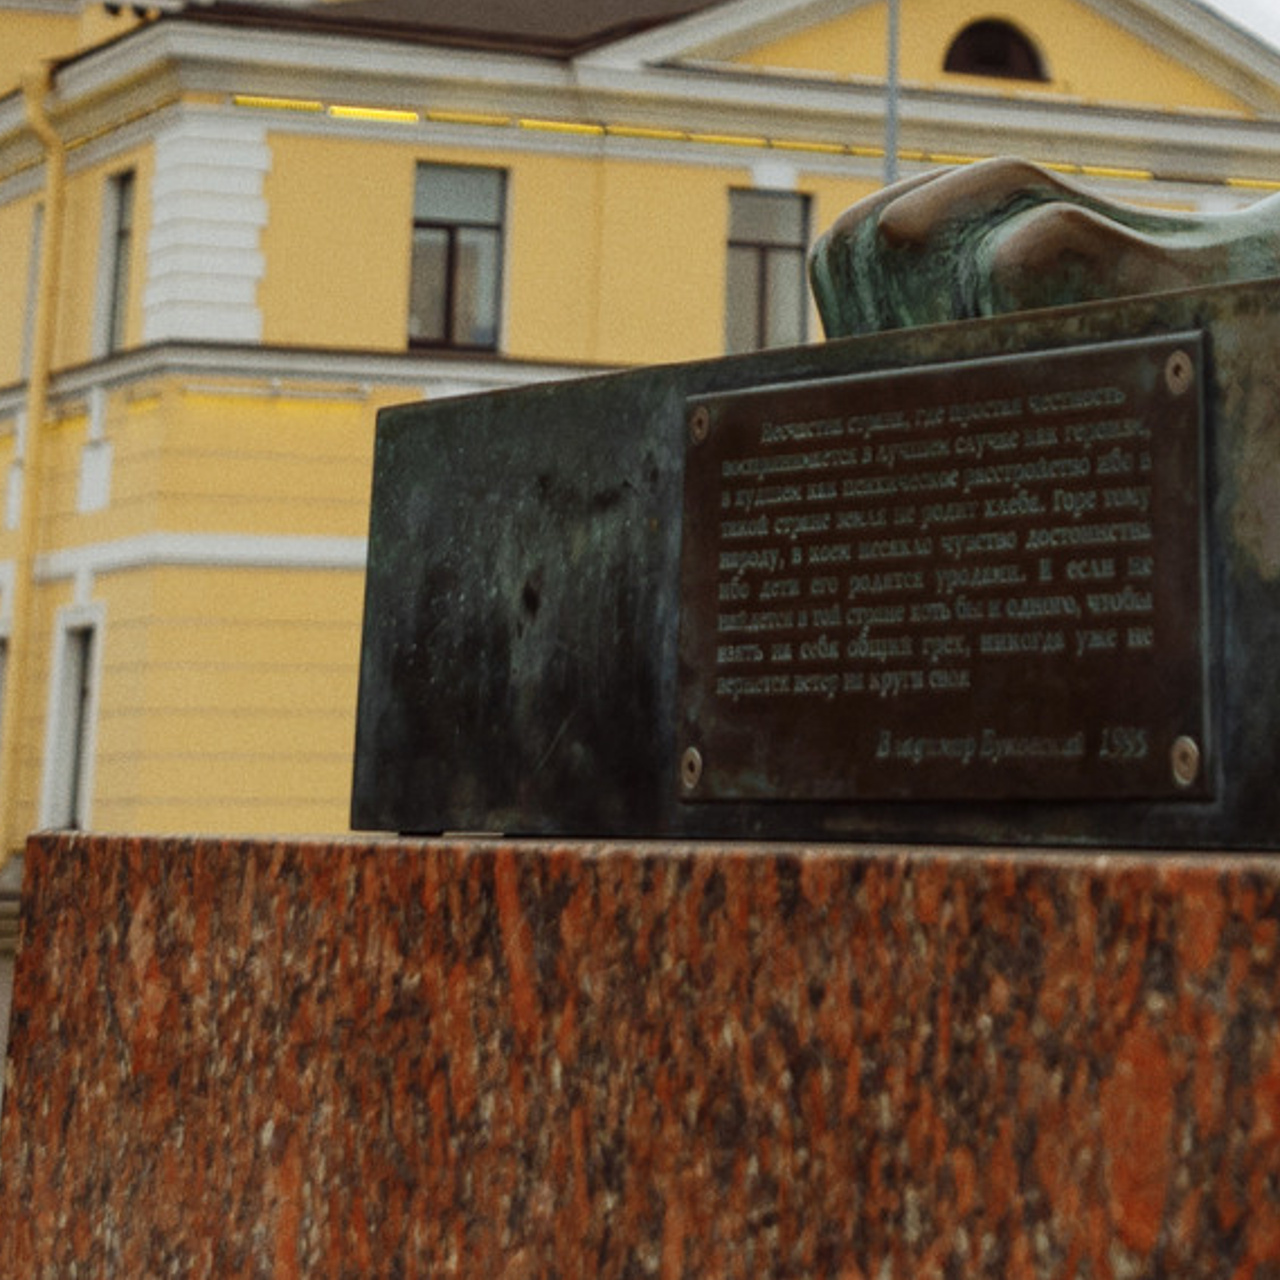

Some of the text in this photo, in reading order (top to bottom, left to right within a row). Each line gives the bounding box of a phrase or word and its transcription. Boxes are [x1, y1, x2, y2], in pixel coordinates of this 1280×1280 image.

[915, 406, 945, 426] где
[949, 398, 1022, 428] простая
[1028, 387, 1126, 413] честность
[862, 446, 872, 463] в
[955, 430, 1019, 459] случае
[1024, 427, 1058, 447] как
[721, 490, 731, 509] в
[807, 481, 837, 500] как
[1139, 452, 1152, 471] в
[721, 513, 768, 538] такой
[774, 513, 830, 539] стране
[836, 508, 887, 529] земля
[893, 506, 916, 525] не
[920, 501, 978, 530] родит
[1052, 489, 1097, 518] Горе
[1102, 486, 1152, 512] тому
[719, 548, 785, 576] народу,
[791, 547, 802, 565] в
[808, 544, 851, 563] коем
[858, 538, 933, 559] иссякло
[941, 531, 1018, 559] чувство
[719, 577, 750, 600] ибо
[759, 578, 800, 601] дети
[810, 576, 838, 595] его
[848, 572, 924, 599] родятся
[1038, 557, 1053, 581] И
[1066, 557, 1115, 580] если
[1127, 556, 1154, 576] не
[797, 609, 808, 627] в
[812, 603, 841, 626] той
[846, 606, 904, 632] стране
[910, 602, 951, 622] хоть
[956, 595, 983, 620] бы
[1006, 595, 1081, 619] одного,
[1086, 585, 1153, 613] чтобы
[717, 626, 1154, 662] взять на себя общий грех, никогда уже не
[793, 675, 839, 699] ветер
[843, 672, 864, 691] на
[870, 671, 923, 697] круги
